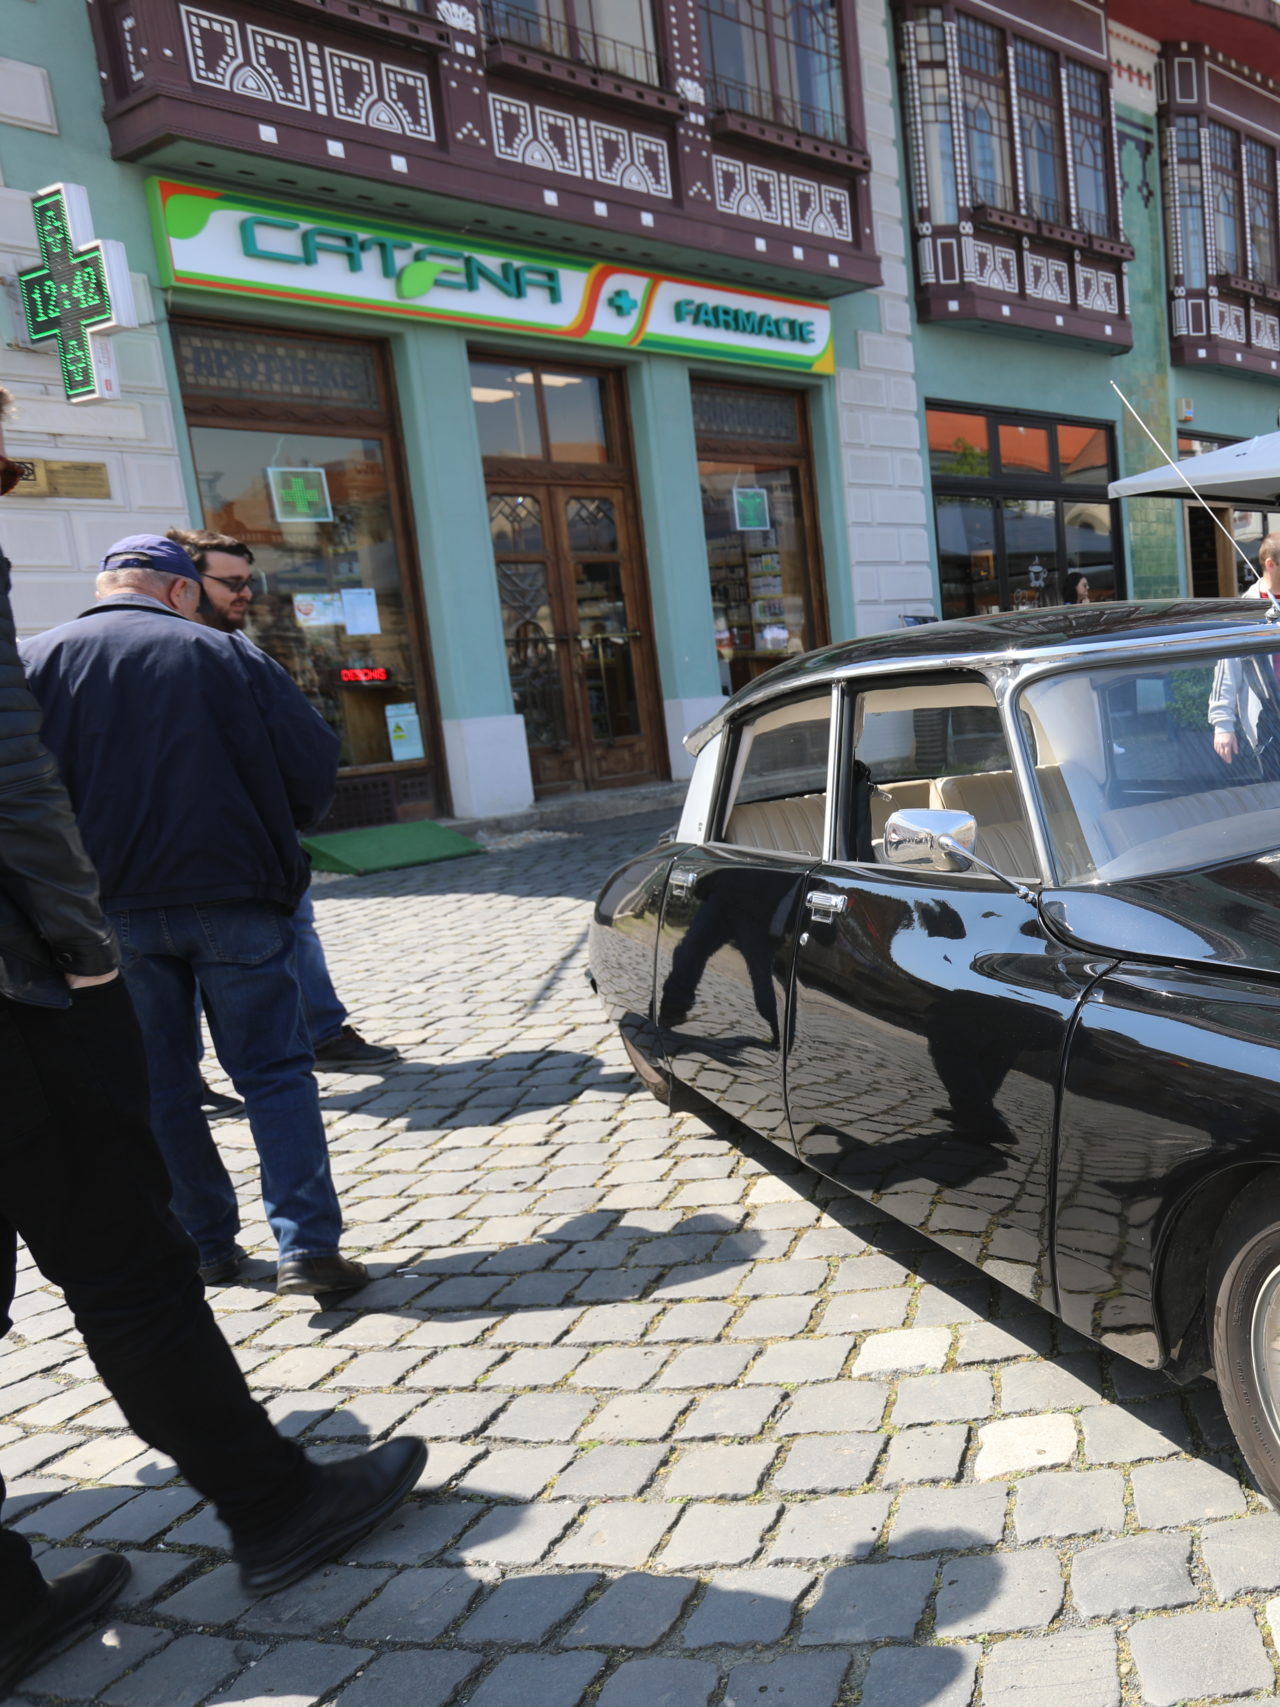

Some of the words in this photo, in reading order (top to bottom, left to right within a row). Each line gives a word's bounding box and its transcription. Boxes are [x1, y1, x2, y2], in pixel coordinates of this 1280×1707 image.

[239, 215, 562, 304] CATENA
[674, 298, 816, 344] FARMACIE
[341, 667, 387, 681] DESCHIS
